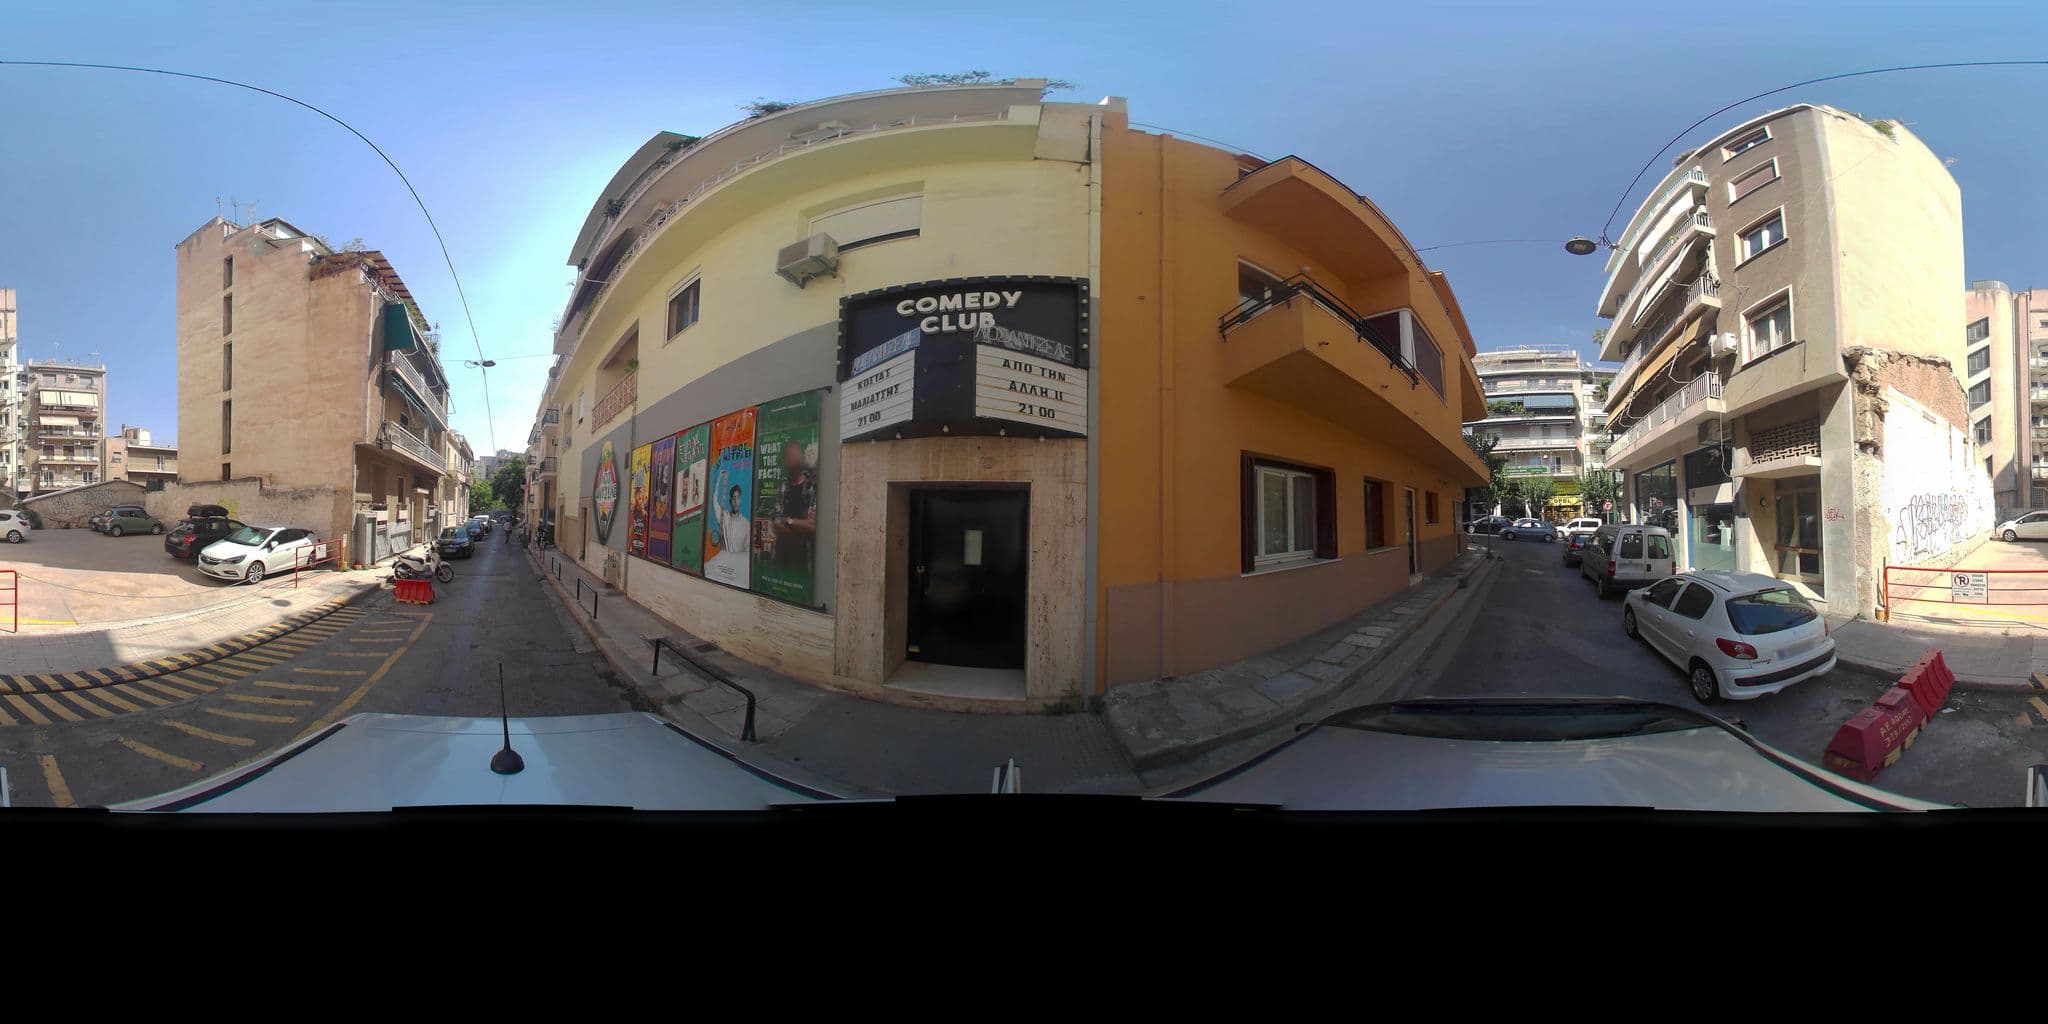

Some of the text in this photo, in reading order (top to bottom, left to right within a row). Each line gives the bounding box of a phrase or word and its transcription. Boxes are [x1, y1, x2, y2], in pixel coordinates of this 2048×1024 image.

[896, 290, 1022, 317] COMEDY
[920, 312, 995, 335] CLUB
[1003, 359, 1066, 383] ΑΠΟ ΤΗΝ
[1009, 380, 1048, 400] ΑΛΛΗ
[760, 442, 782, 455] WHAT
[763, 455, 778, 467] THE
[758, 468, 782, 480] FACT?
